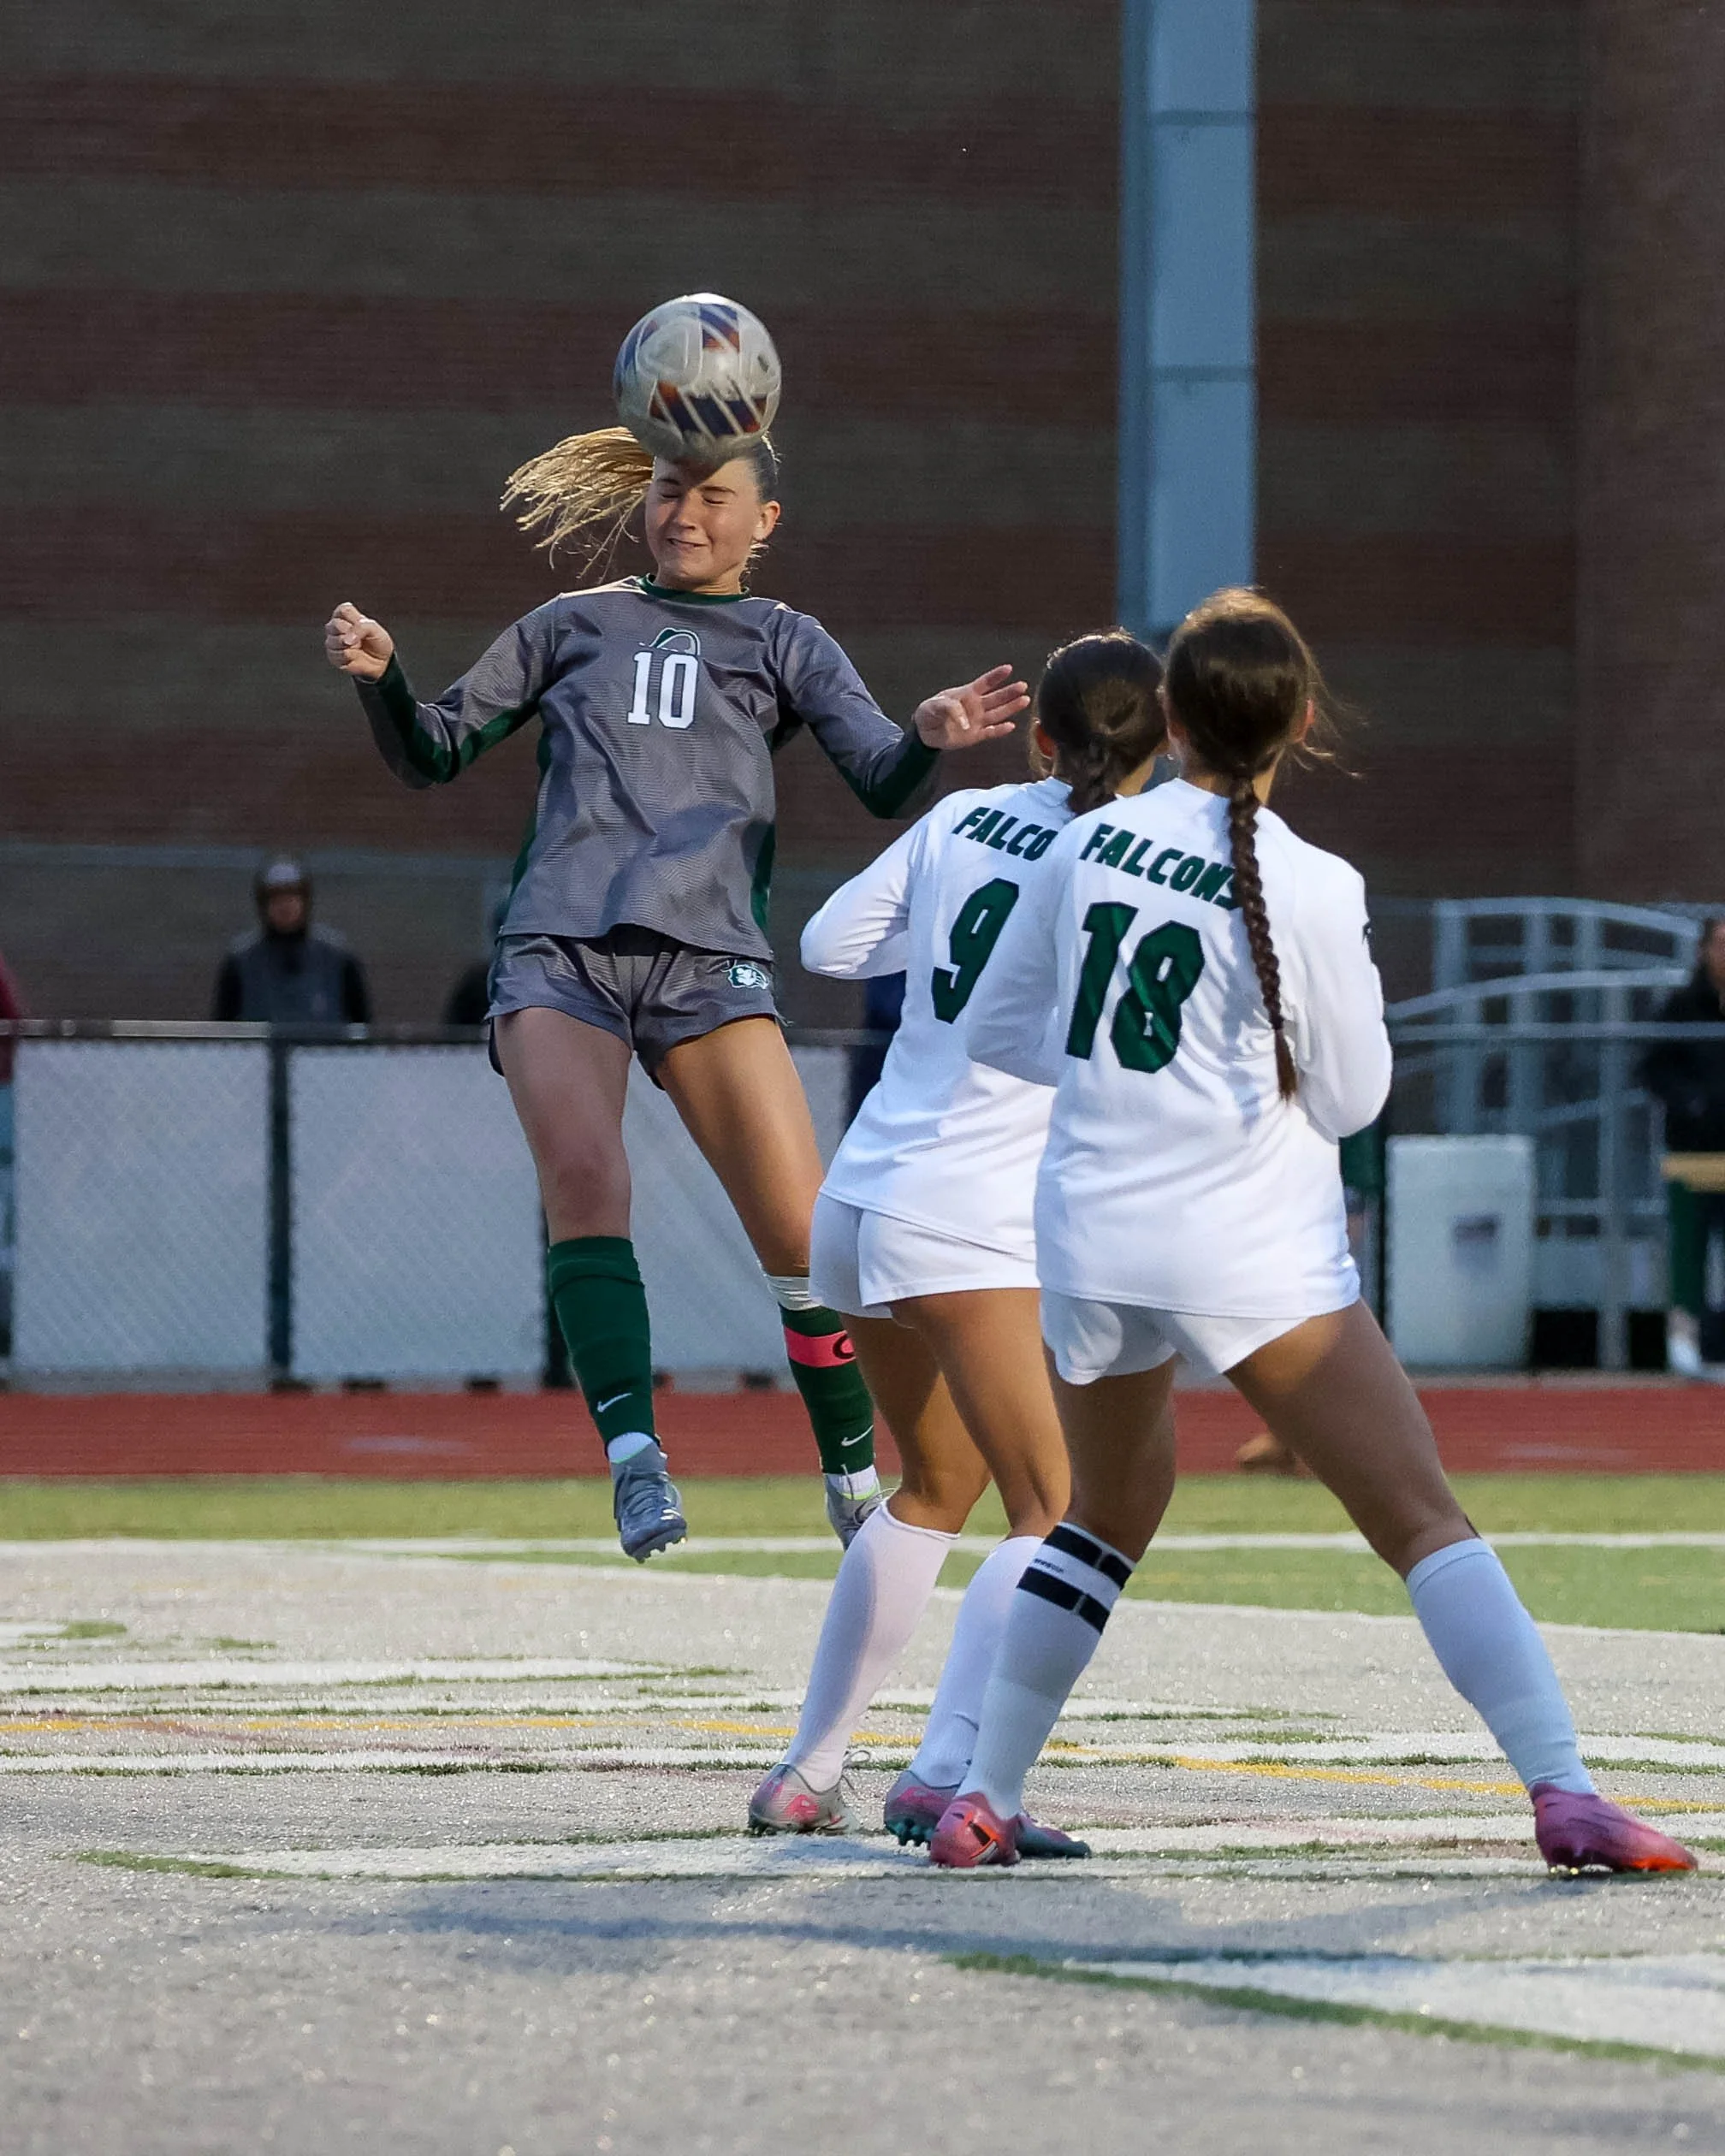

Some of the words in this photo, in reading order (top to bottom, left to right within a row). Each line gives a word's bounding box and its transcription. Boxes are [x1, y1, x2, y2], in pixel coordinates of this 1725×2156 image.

[626, 651, 699, 729] 10
[951, 807, 1058, 862] FALCO
[931, 878, 1020, 1024] 9
[1065, 901, 1205, 1074] 18
